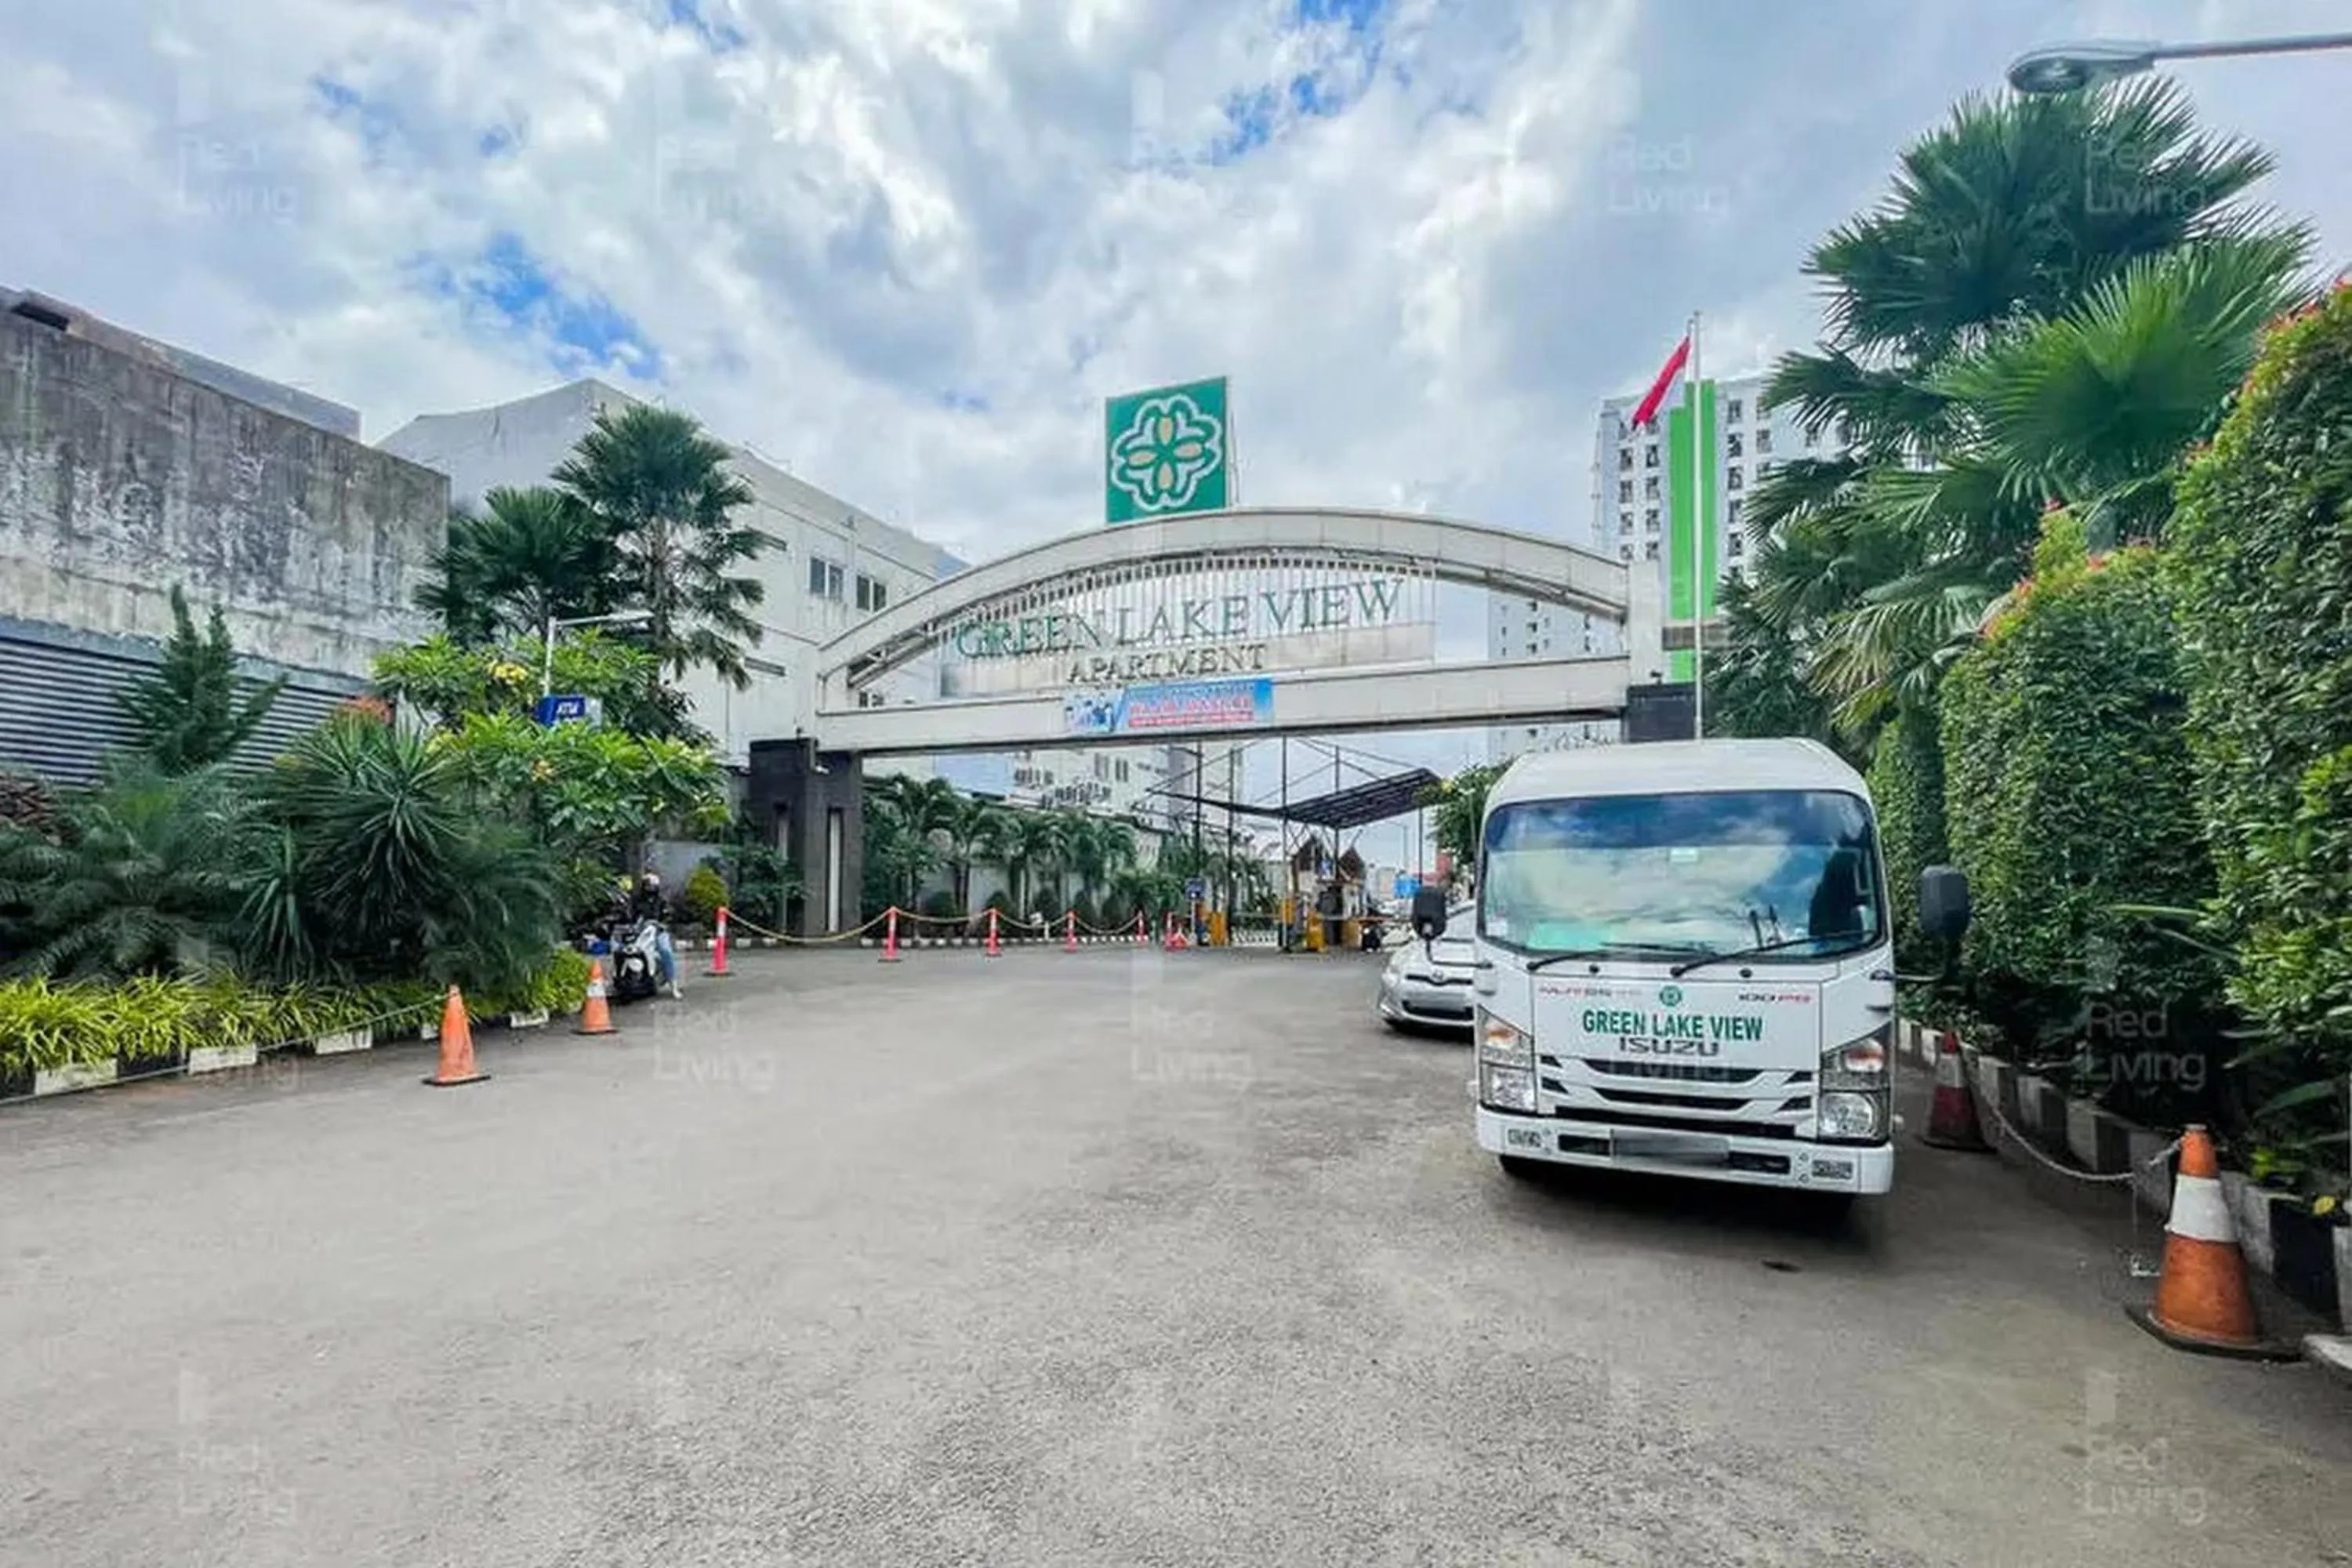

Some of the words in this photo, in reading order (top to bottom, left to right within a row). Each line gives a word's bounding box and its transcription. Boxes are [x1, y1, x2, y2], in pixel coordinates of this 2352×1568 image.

[955, 612, 1102, 659] GREEN
[1116, 594, 1248, 644] LAKE
[1260, 579, 1405, 629] VIEW
[1066, 644, 1267, 685] APARTMENT
[1582, 1009, 1646, 1036] GREEN
[1652, 1014, 1704, 1039] LAKE
[1710, 1016, 1763, 1041] VIEW
[1619, 1036, 1719, 1057] ISUZU
